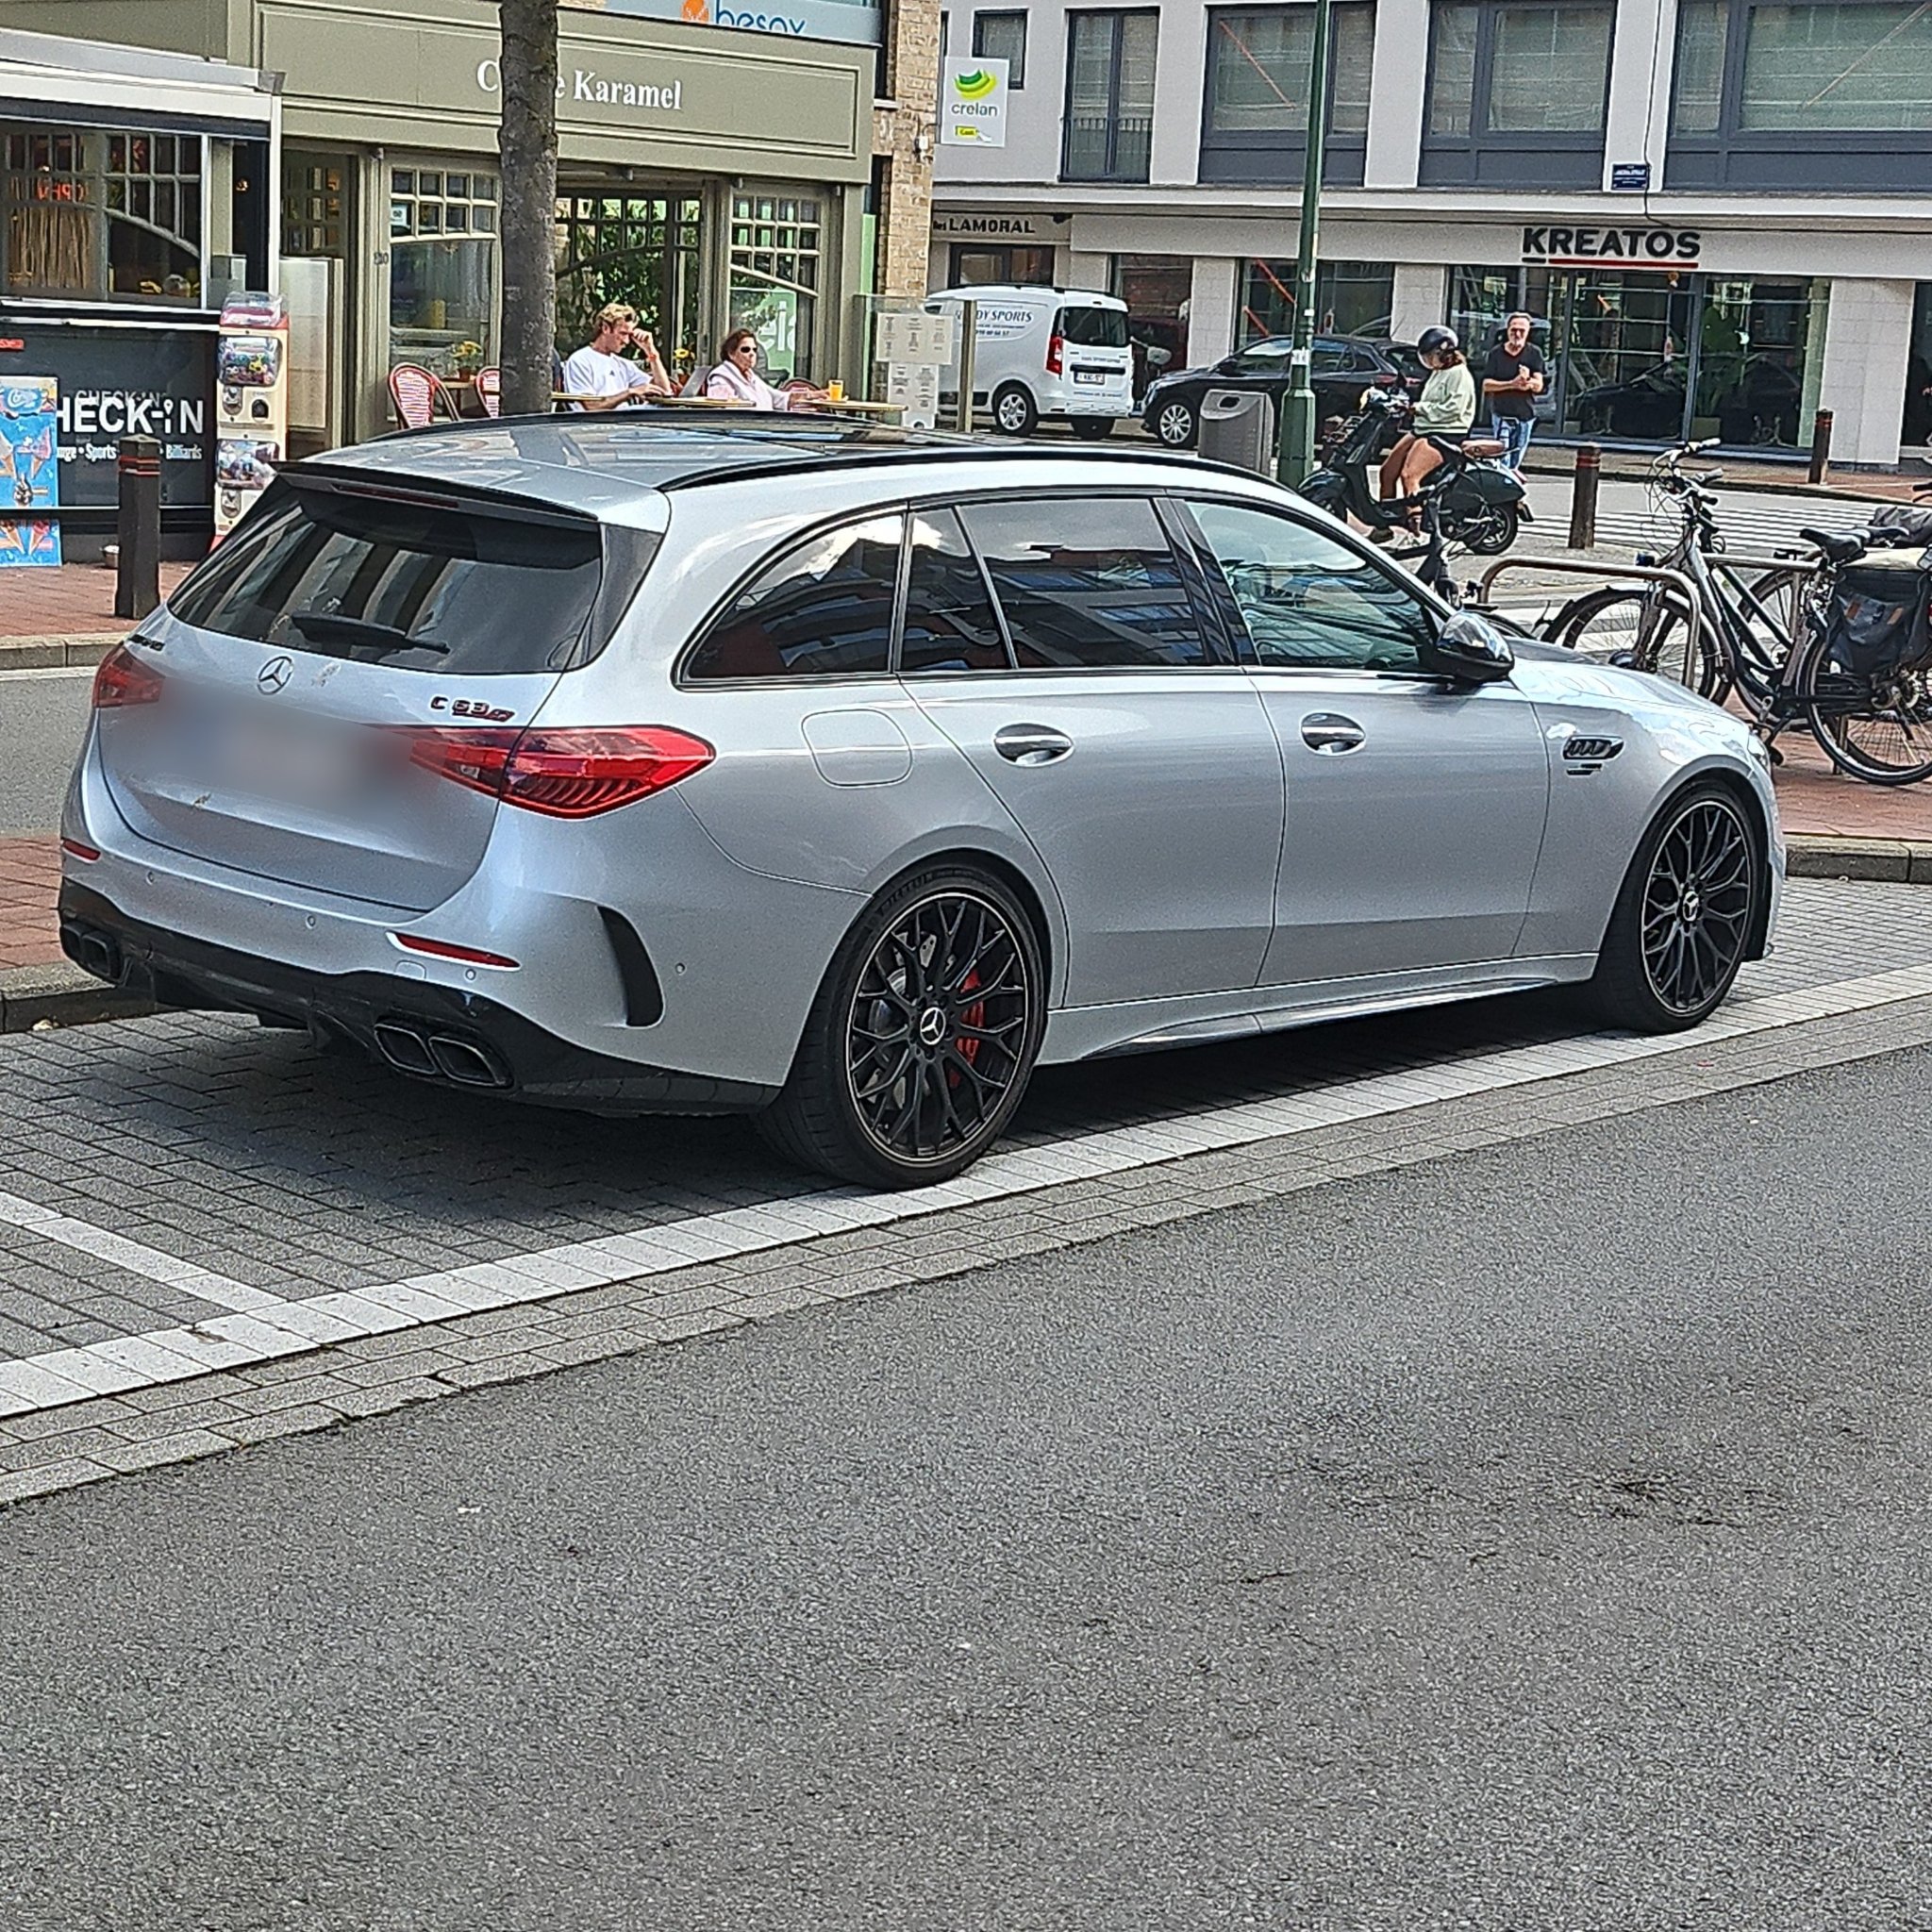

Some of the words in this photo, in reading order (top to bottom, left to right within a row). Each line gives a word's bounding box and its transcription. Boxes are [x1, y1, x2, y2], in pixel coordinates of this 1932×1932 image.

[574, 70, 682, 109] Karamel
[951, 102, 997, 117] crelan
[949, 218, 1036, 233] LAMORAL
[1522, 227, 1701, 258] KREATOS
[991, 309, 1033, 322] SPORTS
[430, 696, 449, 709] C
